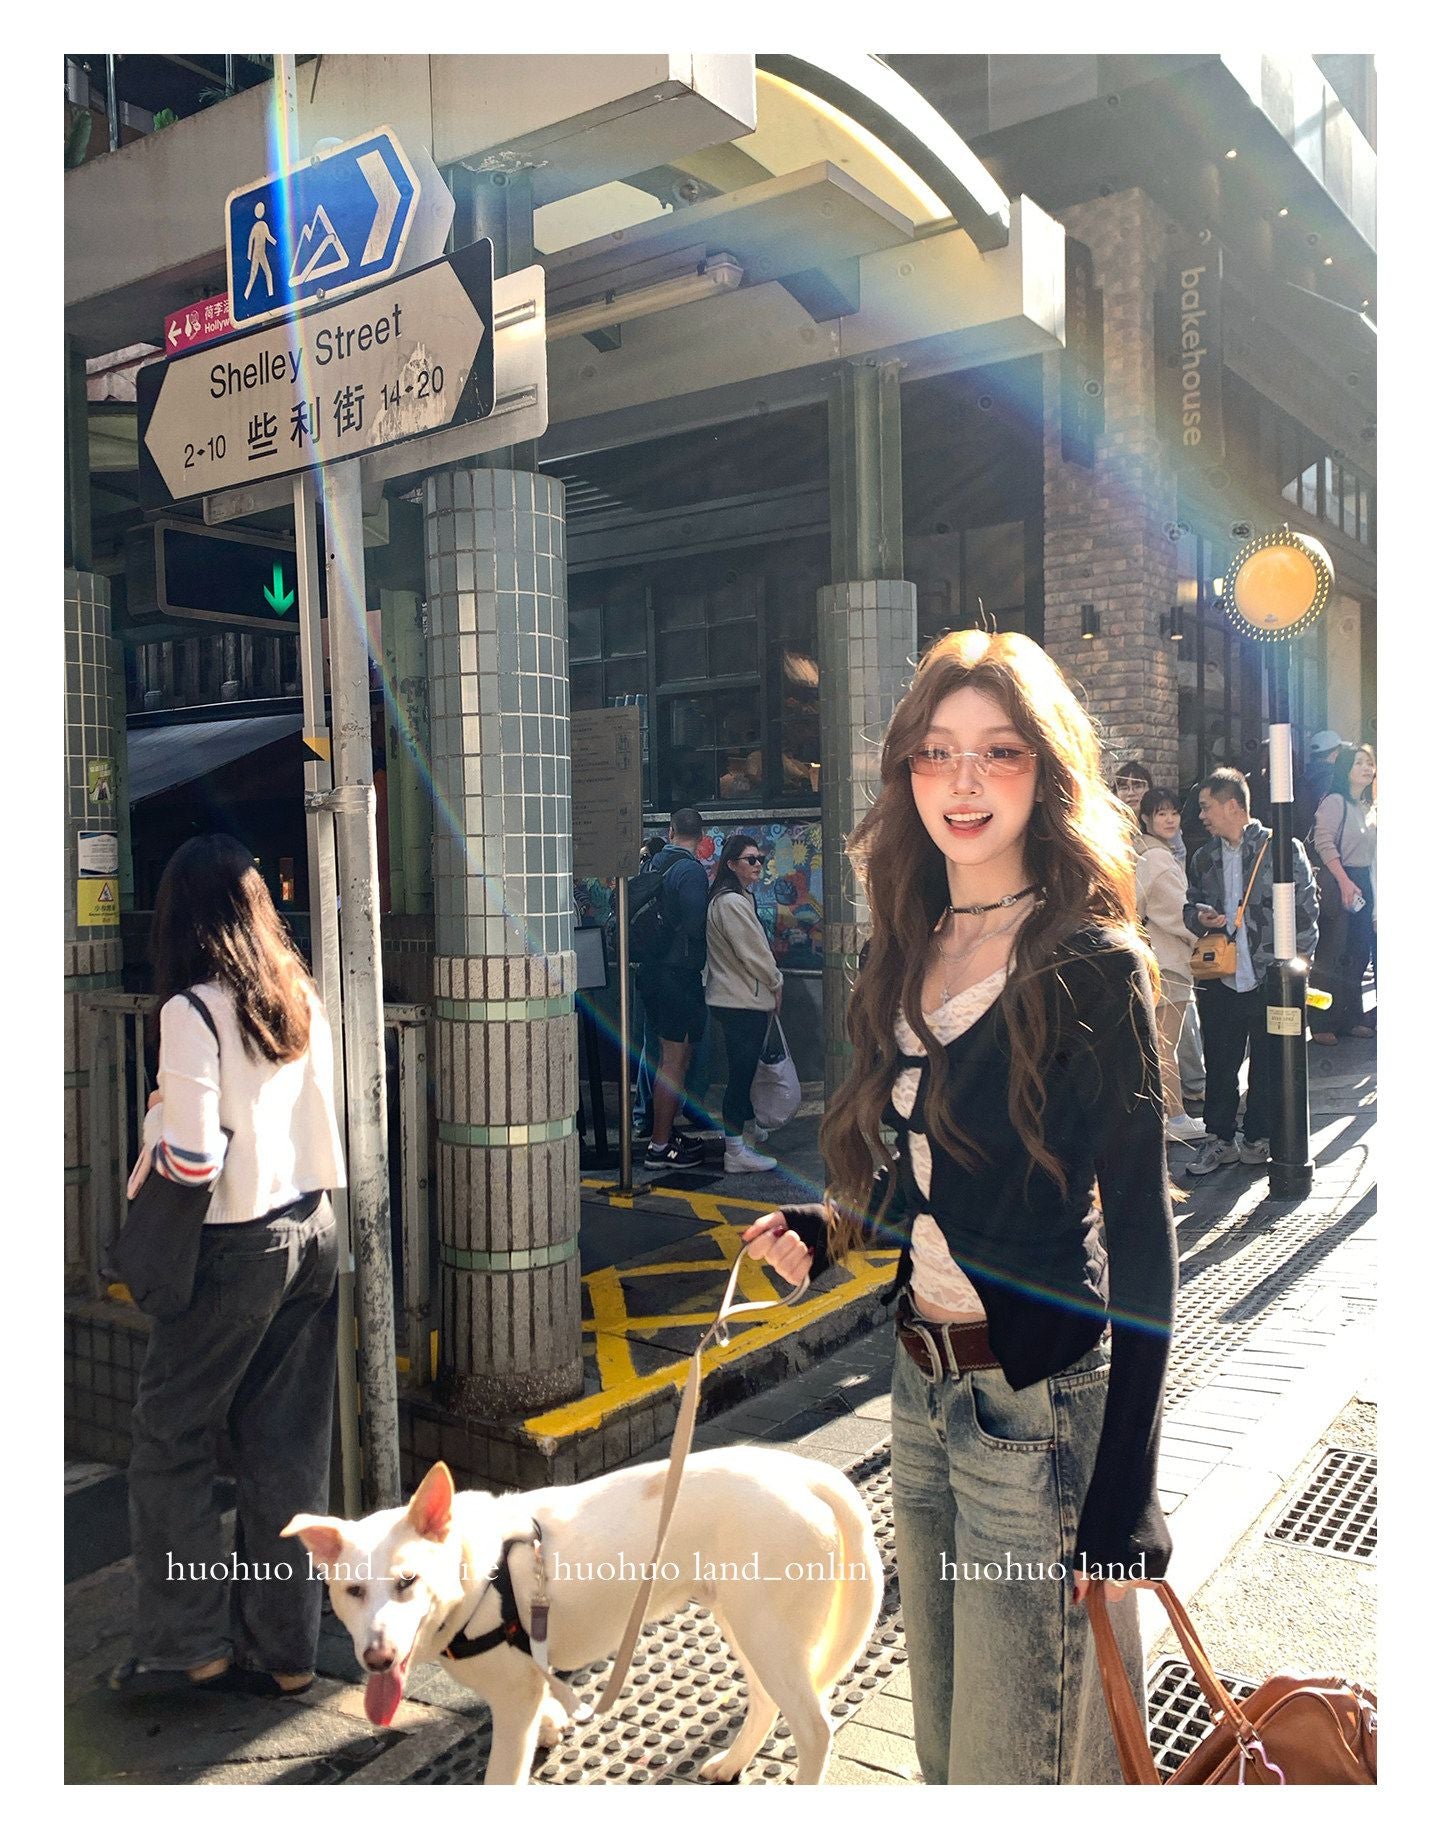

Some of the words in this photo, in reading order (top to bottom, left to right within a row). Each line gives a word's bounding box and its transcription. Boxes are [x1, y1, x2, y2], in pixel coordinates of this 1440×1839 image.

[210, 347, 304, 399] Shelley
[315, 303, 402, 366] Street
[1181, 266, 1207, 446] bakehouse
[247, 383, 365, 461] 些利街
